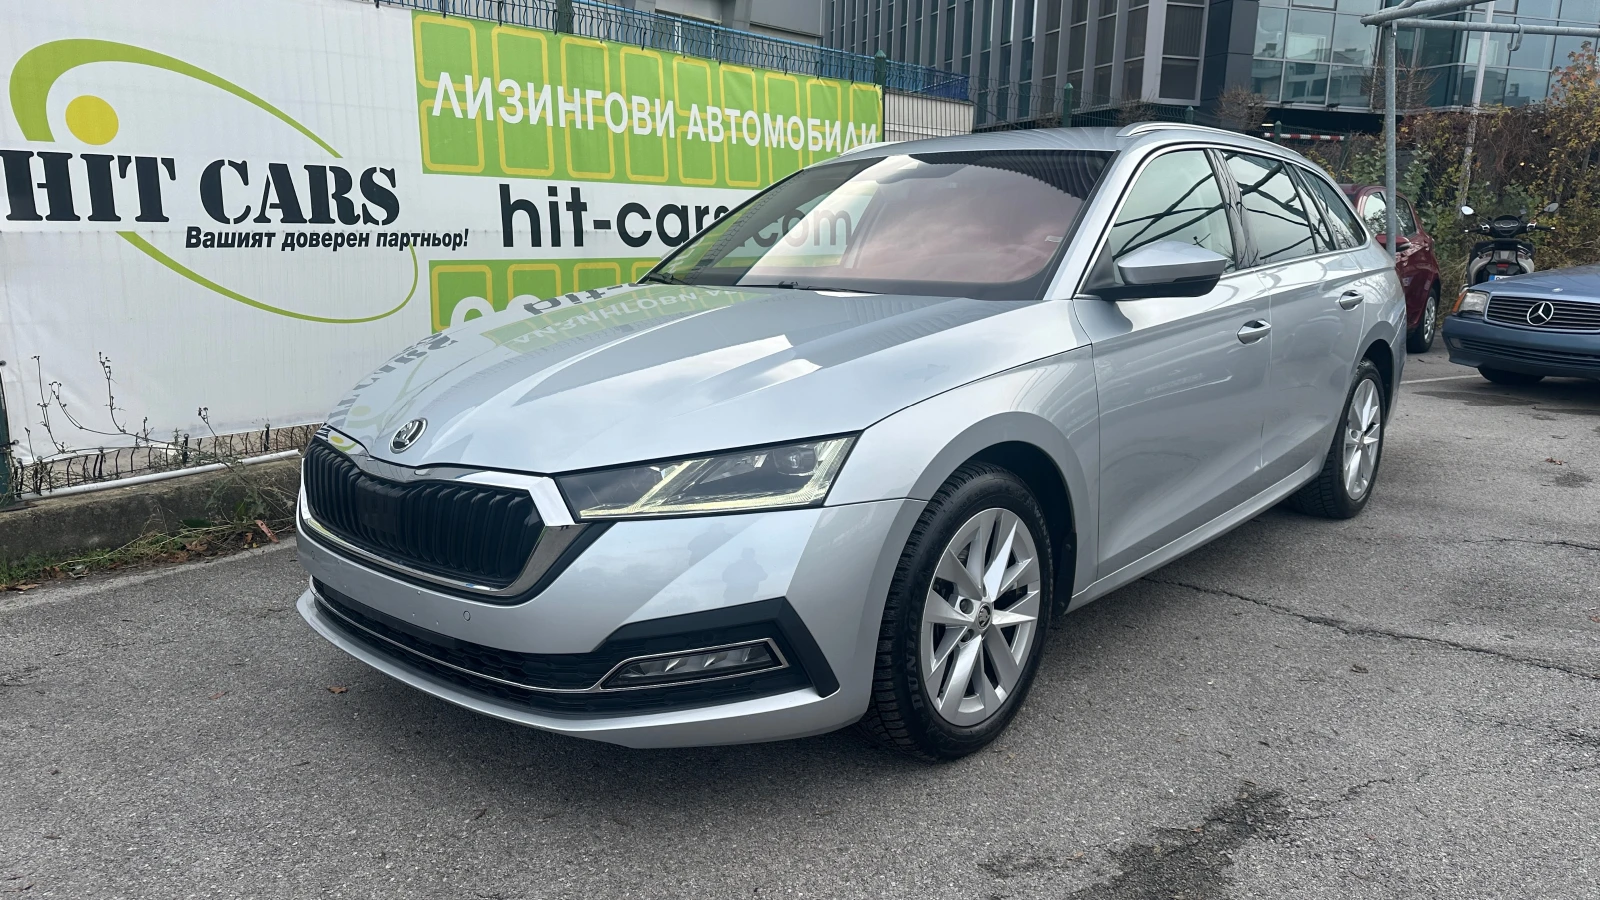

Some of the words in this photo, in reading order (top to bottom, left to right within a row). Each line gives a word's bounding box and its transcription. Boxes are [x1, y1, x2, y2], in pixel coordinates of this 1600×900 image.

[432, 71, 675, 139] ЛИЗИНГОВИ
[687, 103, 877, 154] АВТОМОБИЛИ
[0, 149, 176, 222] HIT
[200, 158, 400, 226] CARS
[185, 226, 275, 250] Вашият
[281, 228, 370, 251] доверен
[376, 228, 469, 252] партньор!
